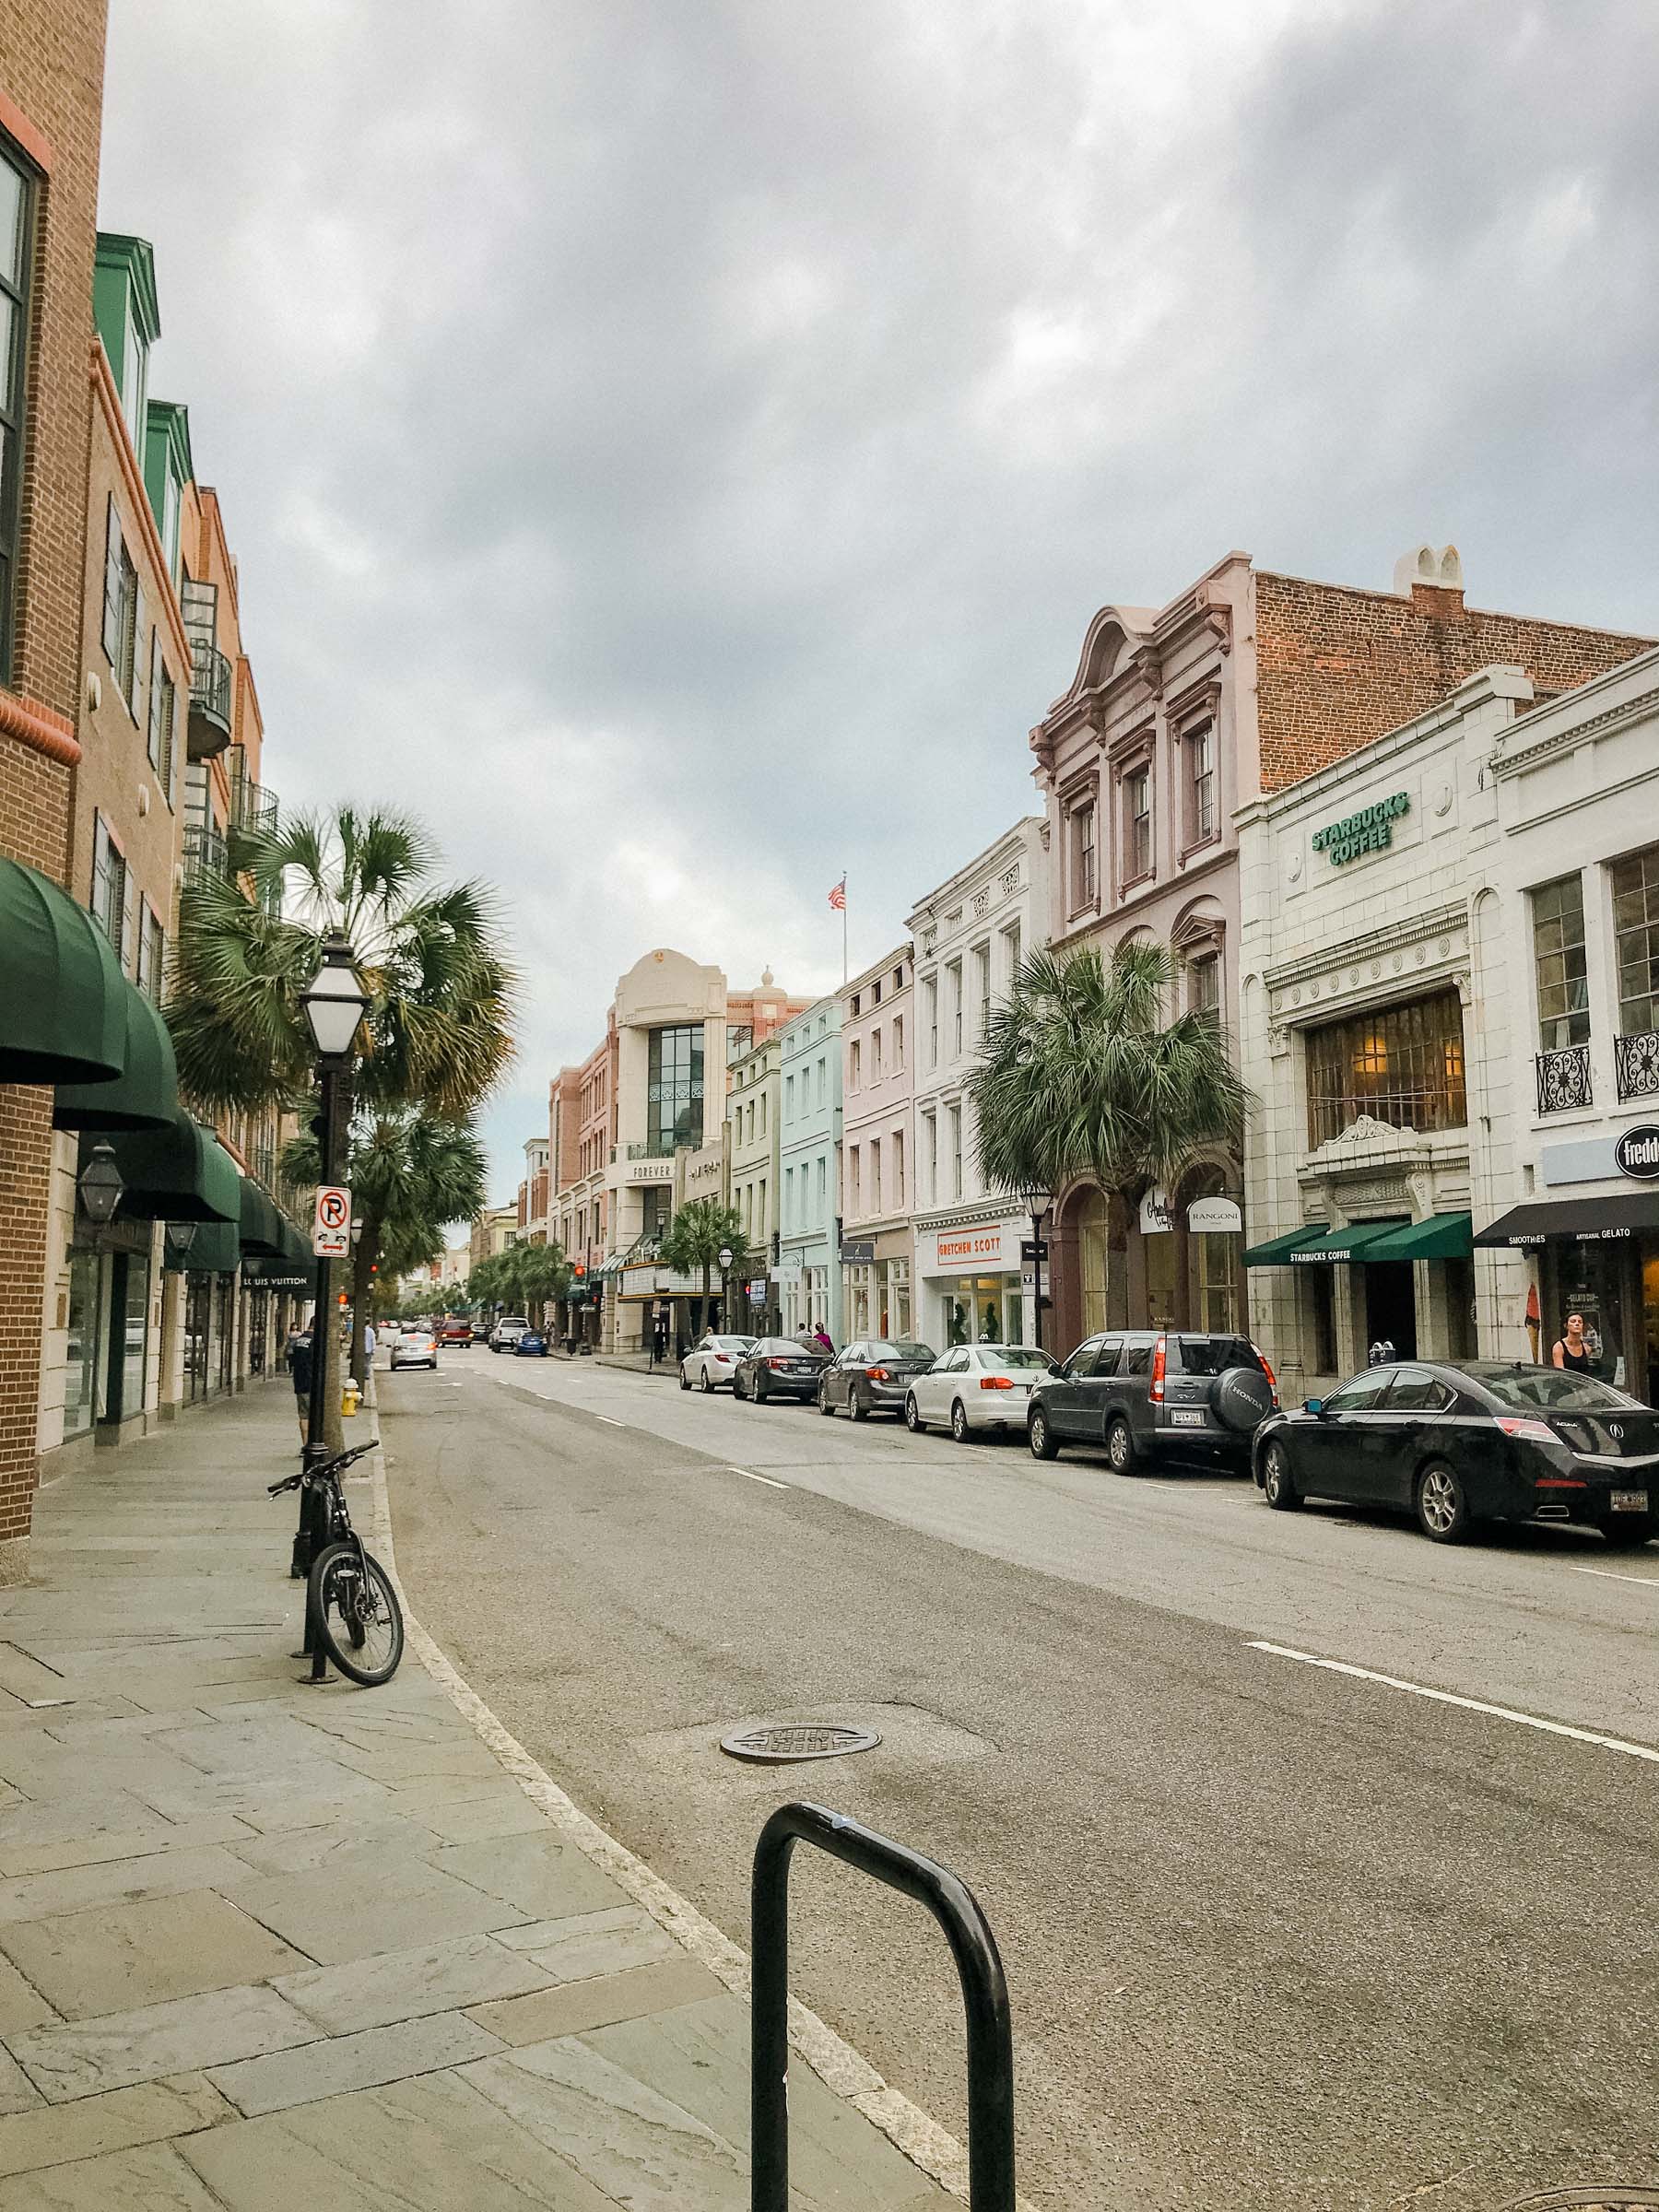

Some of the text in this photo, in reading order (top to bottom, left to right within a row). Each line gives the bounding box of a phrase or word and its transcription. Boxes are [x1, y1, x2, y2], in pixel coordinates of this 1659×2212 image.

[1312, 792, 1408, 851] STARBUCKS
[1330, 824, 1389, 865] COFFEE
[1624, 1136, 1659, 1166] fredd
[633, 1165, 670, 1178] FOREVER
[1508, 1234, 1546, 1245] SMOOTHIES
[1601, 1228, 1630, 1239] GELATO
[939, 1237, 1001, 1255] GRETCHEN SCOTT
[1289, 1250, 1350, 1262] STARBUCKS COFFEE
[271, 1277, 307, 1286] VUITTON
[1231, 1385, 1263, 1410] HONDA
